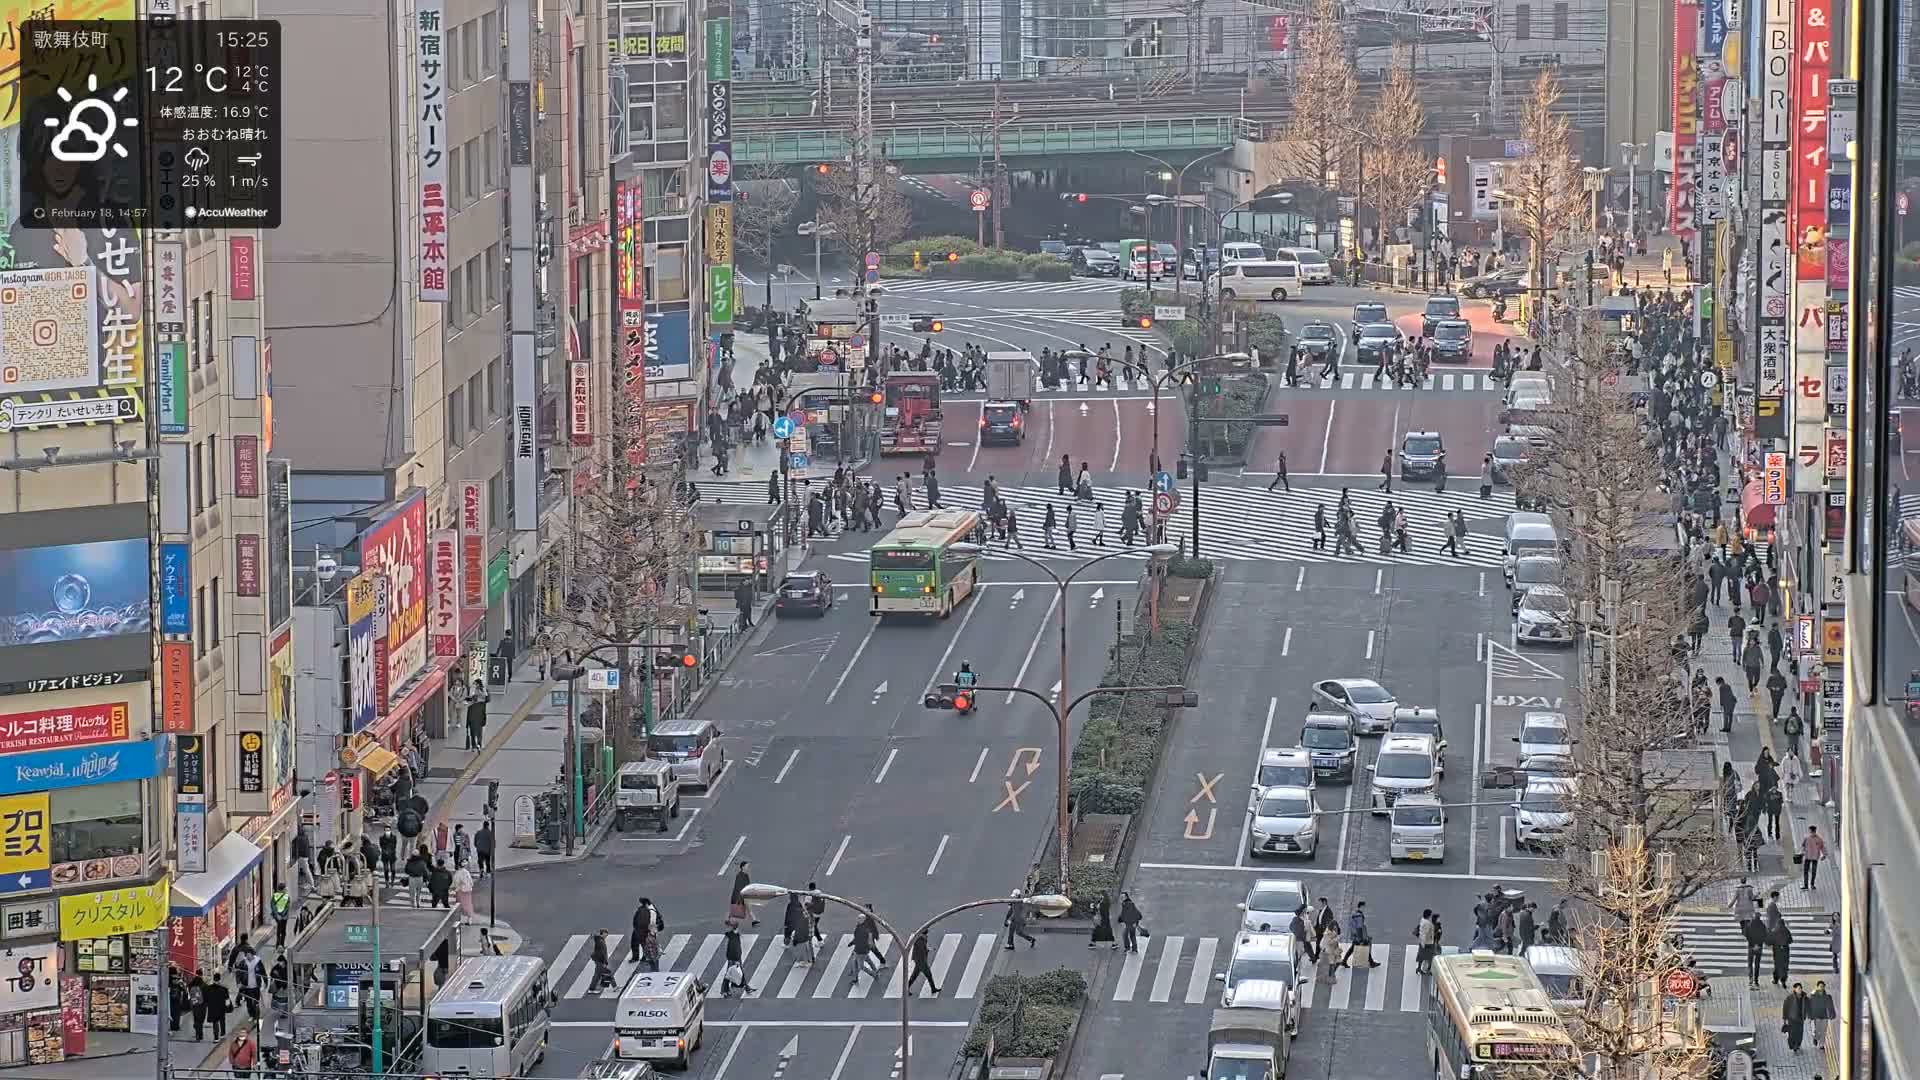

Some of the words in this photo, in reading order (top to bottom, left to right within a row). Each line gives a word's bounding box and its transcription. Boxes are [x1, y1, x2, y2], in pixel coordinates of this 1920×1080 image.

[419, 9, 441, 169] 新宿サンパーク
[423, 183, 446, 291] 三平本館
[1, 274, 44, 286] Instagram
[715, 274, 728, 313] レイク
[161, 322, 179, 332] 3F
[1763, 329, 1777, 381] 大衆酒場
[164, 351, 174, 413] FamilyMart
[1798, 306, 1824, 468] パセラ
[17, 409, 53, 423] テンクリ
[57, 403, 115, 419] たいせい先生
[518, 405, 532, 458] HOMEGAME
[464, 486, 475, 530] GAME
[436, 540, 453, 628] 三平ストア
[29, 734, 73, 747] RESTAURANT
[3, 811, 43, 832] プロ
[4, 835, 44, 857] ミス
[8, 910, 42, 931] 囲碁
[72, 902, 145, 925] クリスタル
[331, 987, 348, 1005] 12
[637, 1010, 668, 1018] ALSOK
